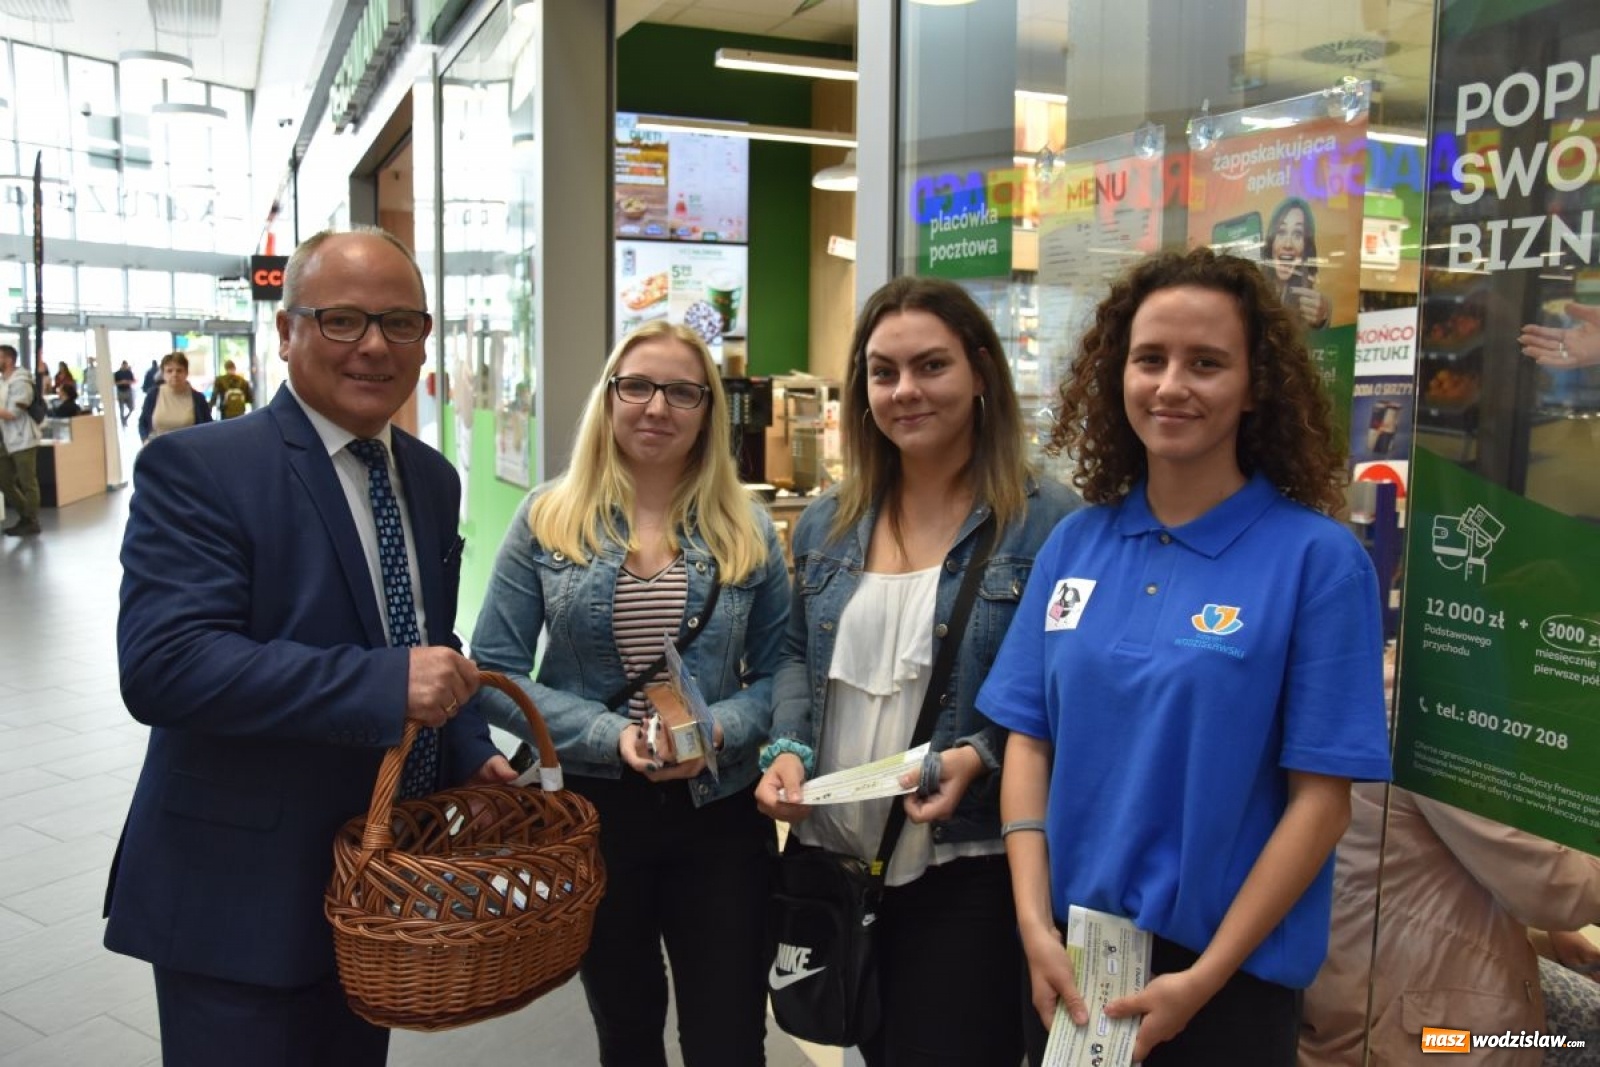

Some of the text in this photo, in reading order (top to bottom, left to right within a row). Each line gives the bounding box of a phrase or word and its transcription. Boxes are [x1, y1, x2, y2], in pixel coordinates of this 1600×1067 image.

[1212, 134, 1337, 172] żappskakująca
[1451, 118, 1600, 204] SWÓ
[1066, 170, 1127, 210] MENU
[1248, 165, 1291, 193] apka!
[930, 202, 998, 241] placówka
[929, 238, 998, 268] pocztowa
[1448, 210, 1600, 273] BIZN
[254, 269, 285, 287] CC
[1354, 345, 1411, 363] SZTUKI
[1423, 623, 1492, 648] Podstawowego
[1425, 597, 1445, 617] 12
[1448, 602, 1485, 625] 000
[1488, 611, 1505, 629] zł
[1546, 622, 1585, 643] 3000
[1422, 639, 1470, 656] przychodu
[1535, 648, 1597, 669] miesięcznie
[1533, 664, 1580, 681] pierwsze
[1436, 702, 1568, 750] tel.: 800 207 208
[1471, 768, 1511, 790] przychodu
[1558, 796, 1581, 811] przez
[1520, 772, 1552, 790] Dotyczy
[775, 942, 811, 974] NIKE
